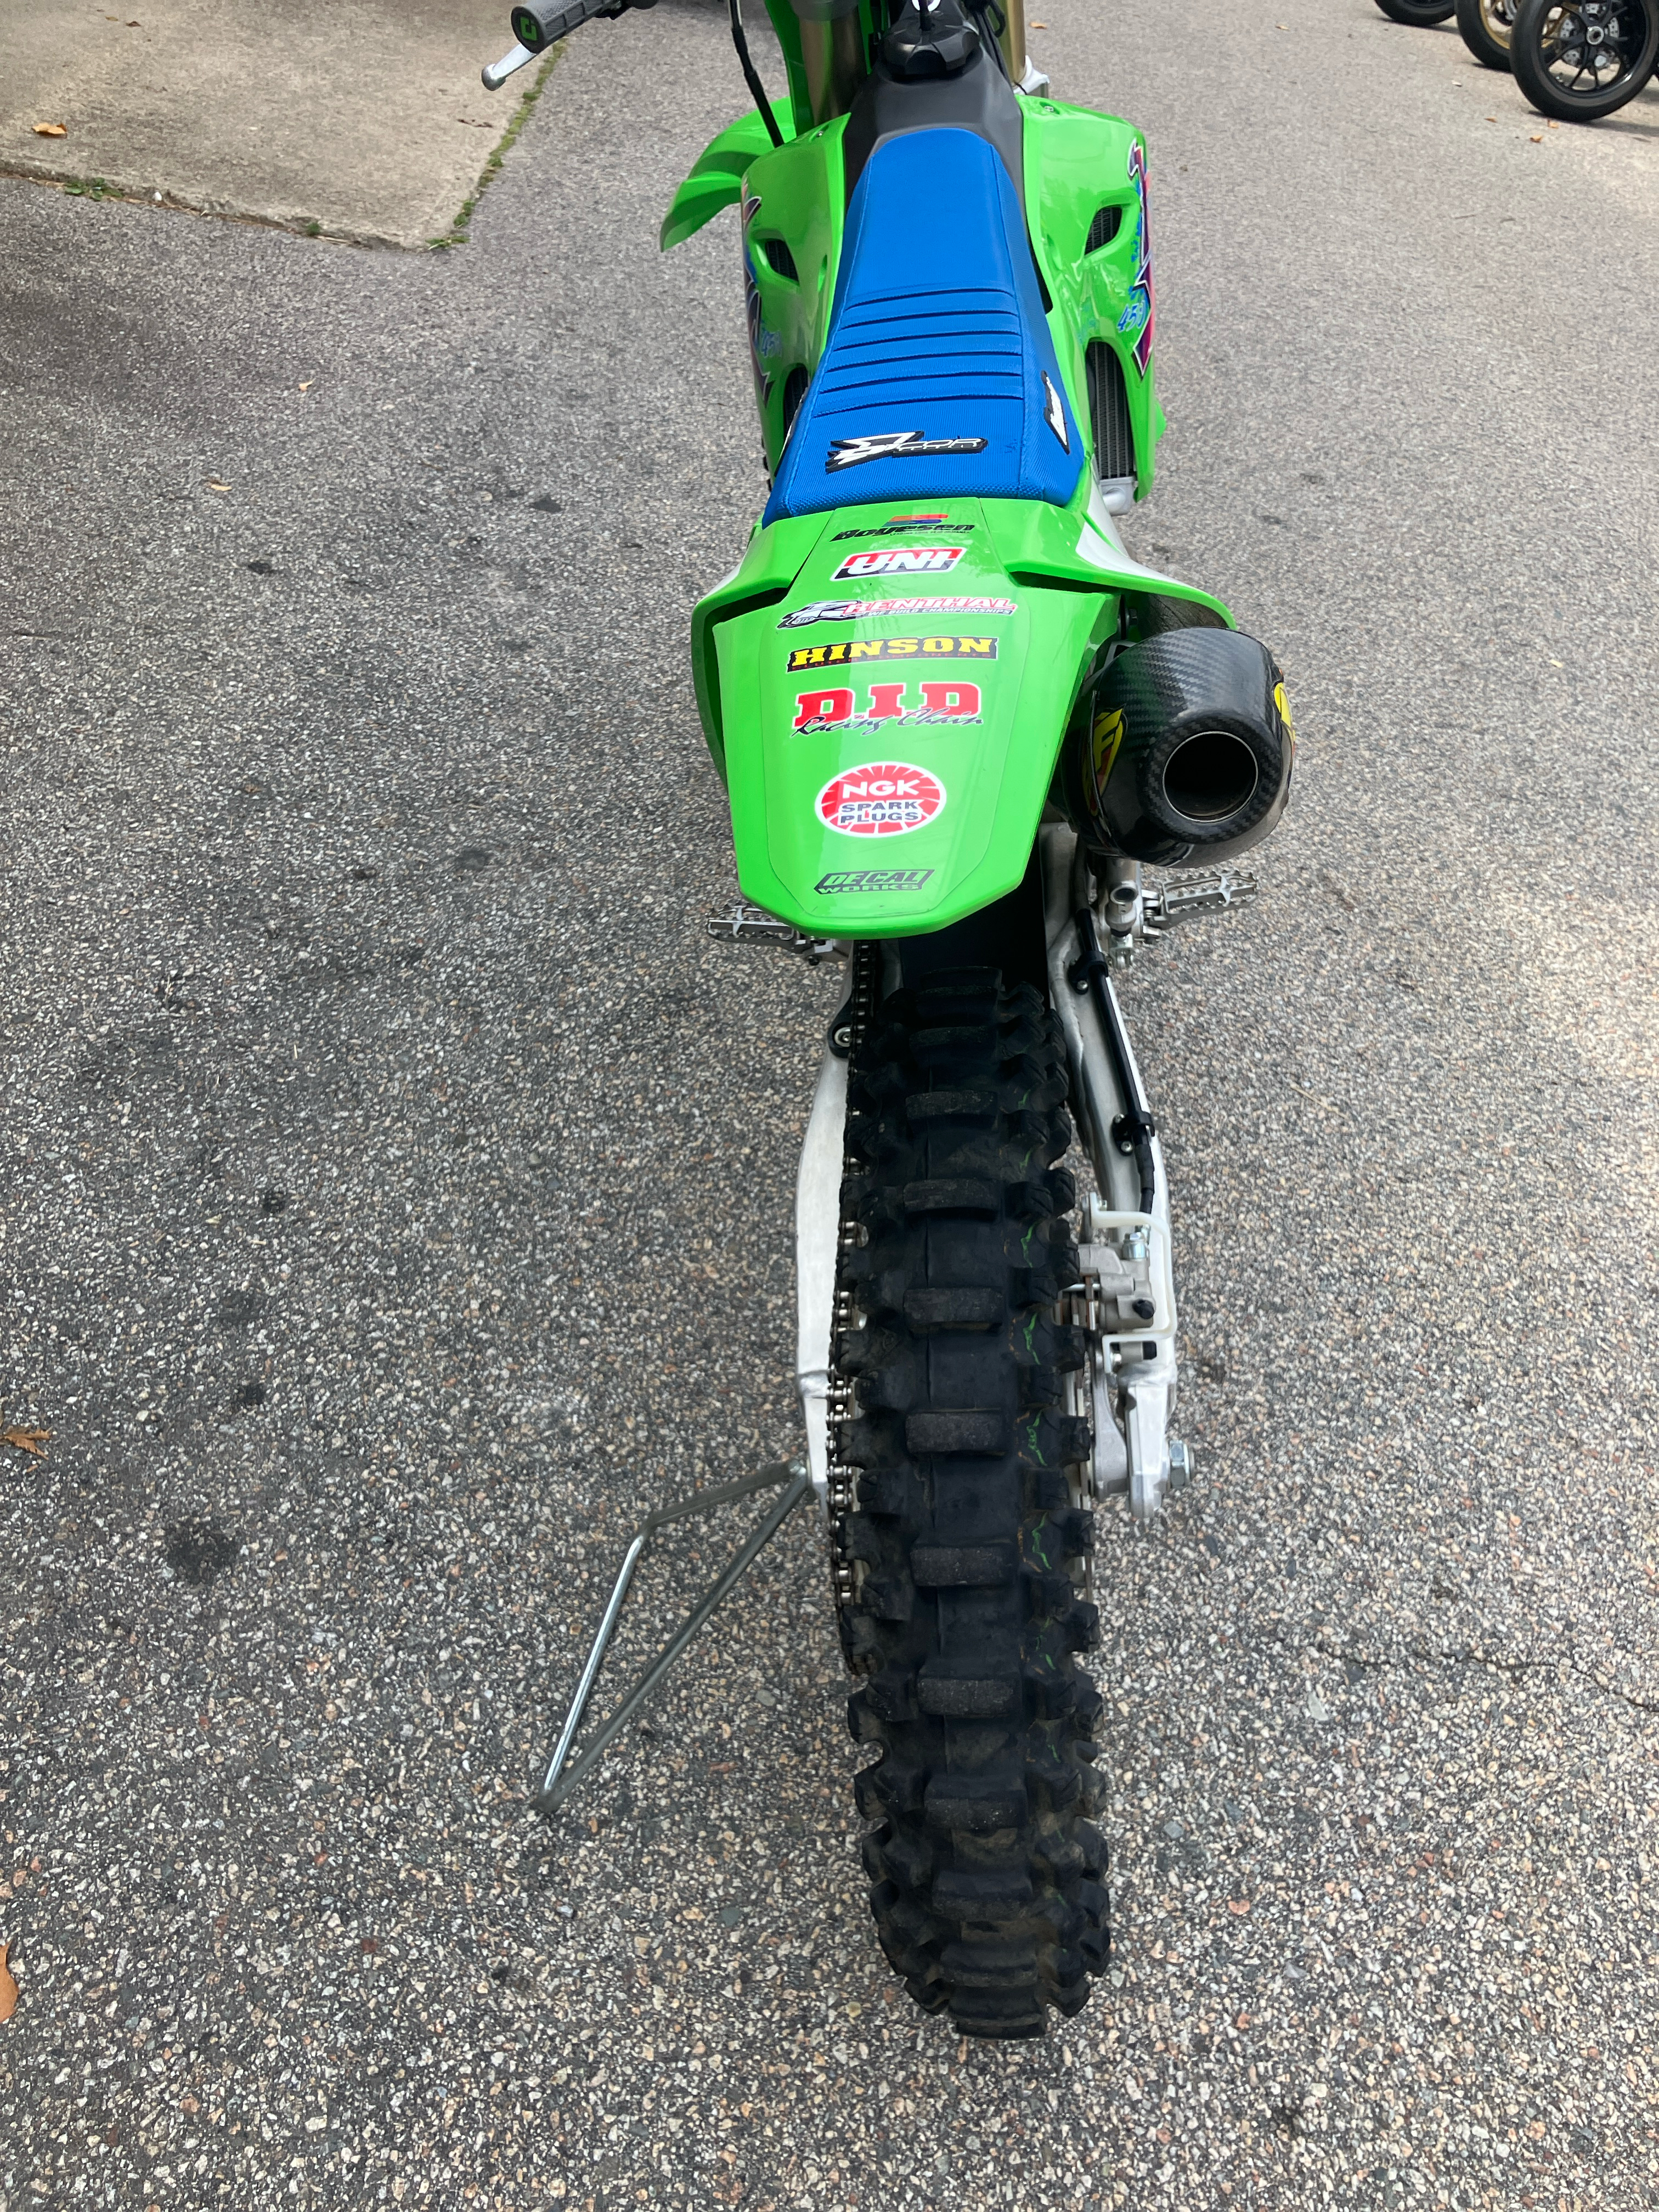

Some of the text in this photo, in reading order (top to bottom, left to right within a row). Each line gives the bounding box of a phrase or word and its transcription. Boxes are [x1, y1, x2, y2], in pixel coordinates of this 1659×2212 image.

[830, 524, 975, 542] Boyesen
[847, 550, 953, 575] UNI
[842, 597, 1016, 614] RENTHAL
[792, 637, 992, 667] HINSON
[791, 708, 984, 737] Racing Chain
[842, 779, 921, 799] NGK
[841, 801, 918, 812] SPARK
[840, 812, 919, 824] PLUGS
[823, 870, 928, 887] DECAL
[818, 884, 919, 894] WORKS
